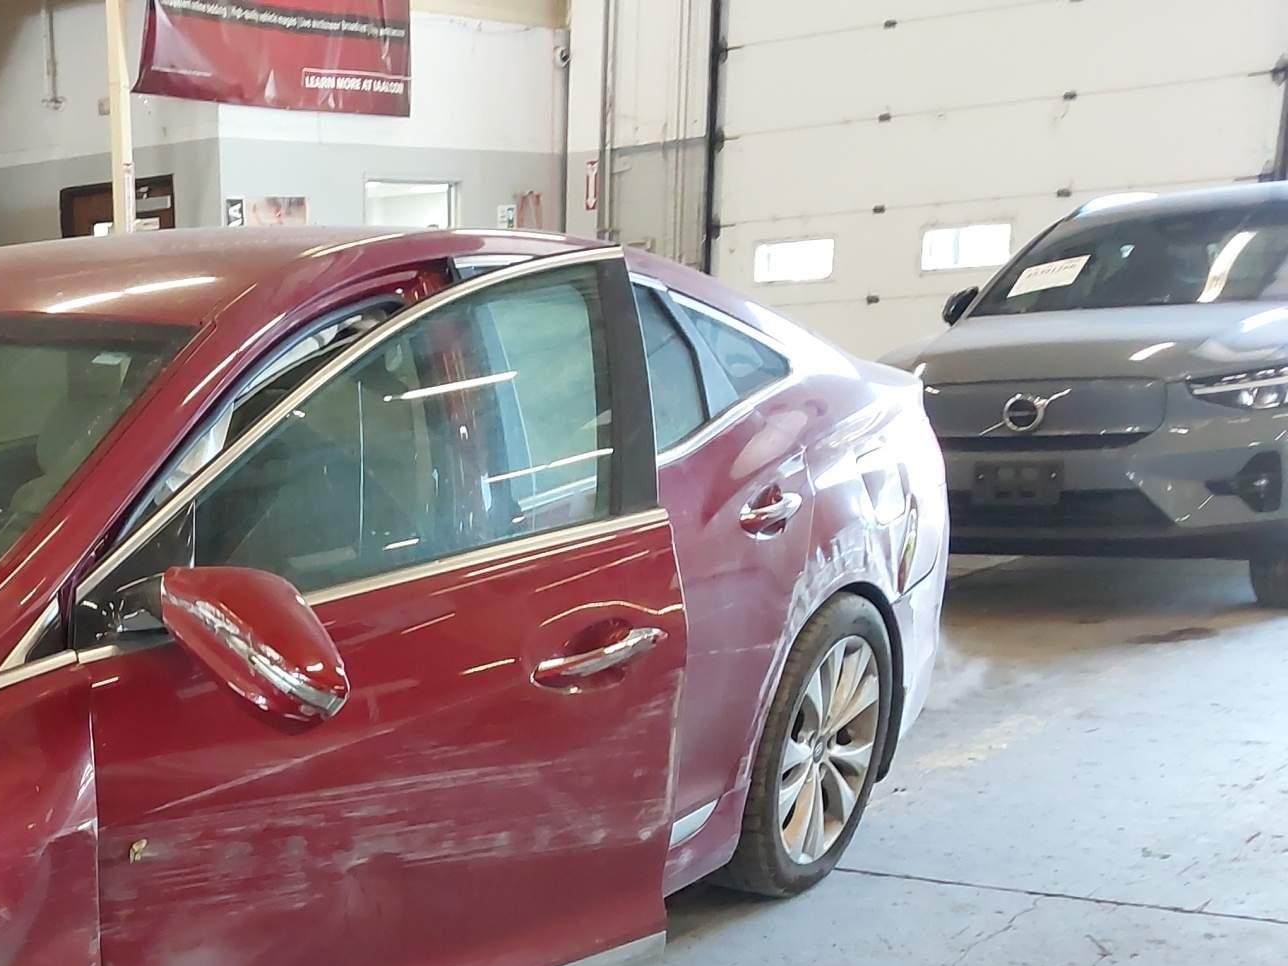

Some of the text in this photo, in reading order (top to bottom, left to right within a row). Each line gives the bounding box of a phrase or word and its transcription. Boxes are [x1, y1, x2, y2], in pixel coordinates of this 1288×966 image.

[305, 75, 335, 88] LEARN
[336, 77, 362, 90] MORE
[361, 79, 373, 91] AT
